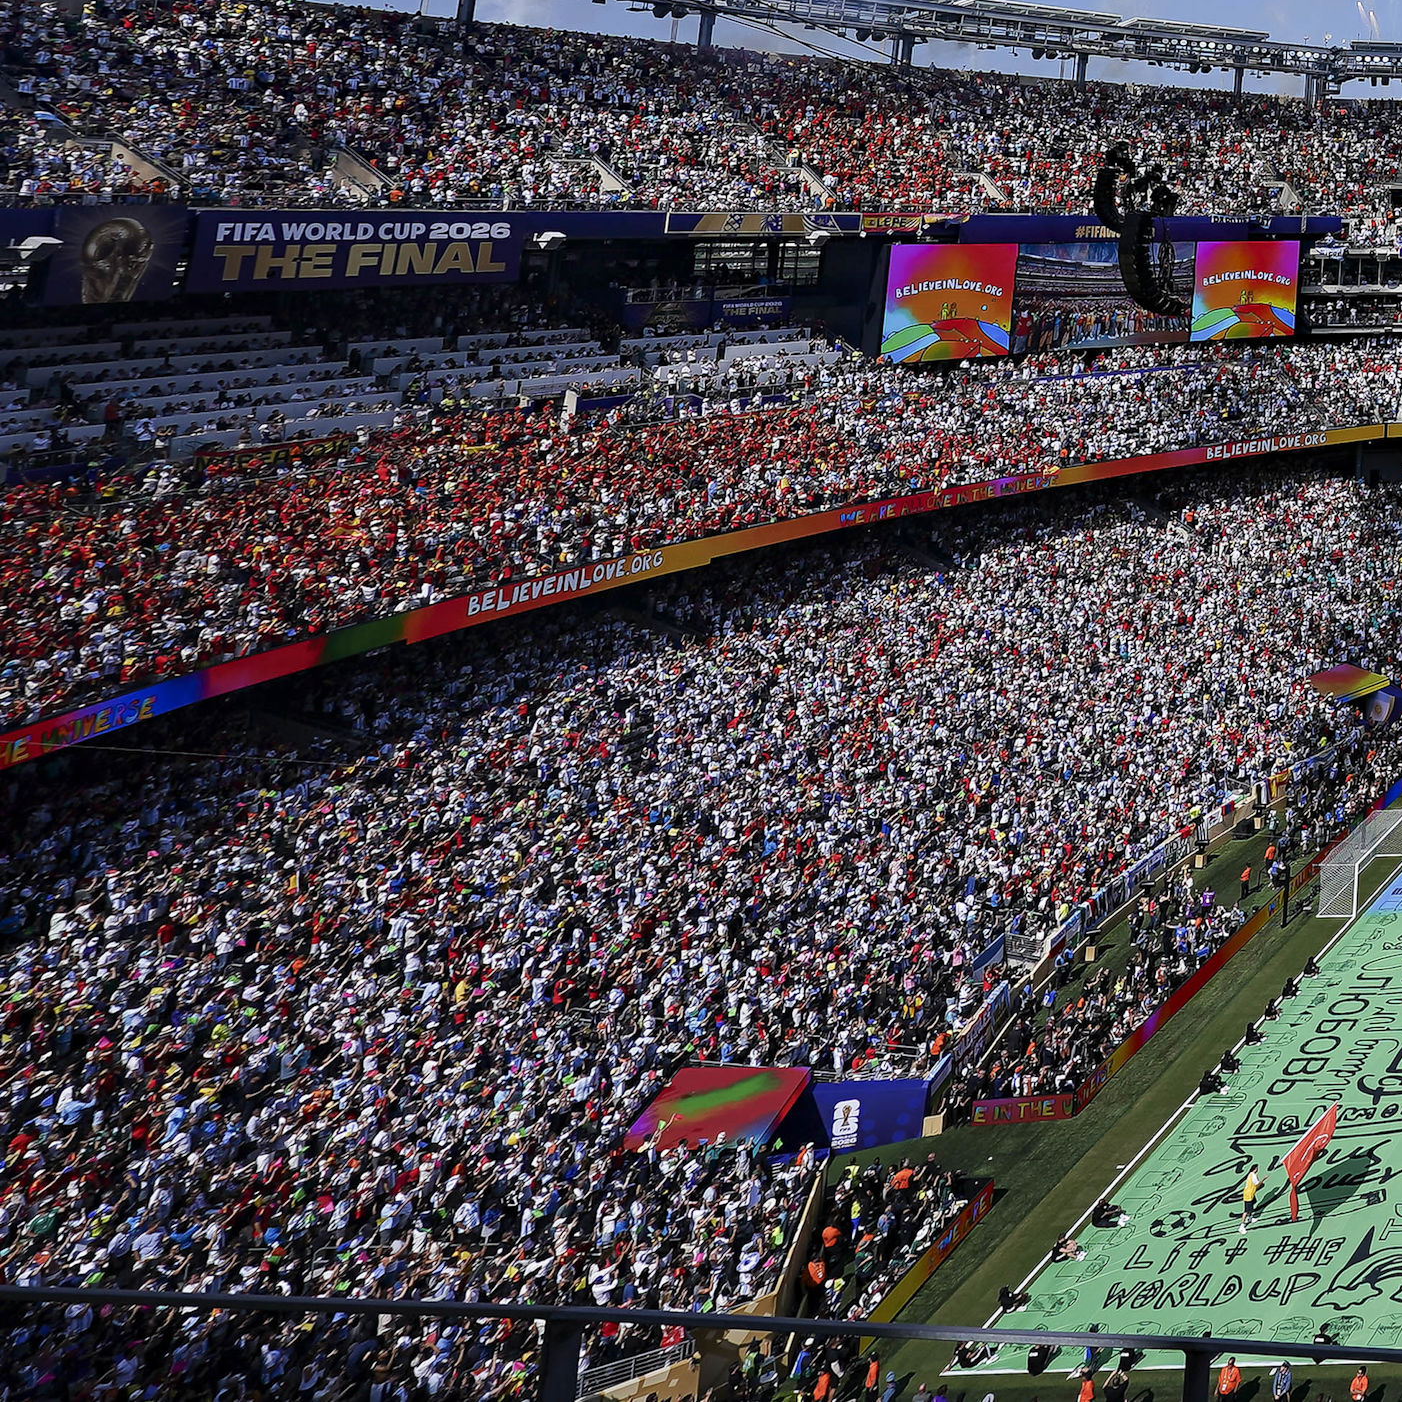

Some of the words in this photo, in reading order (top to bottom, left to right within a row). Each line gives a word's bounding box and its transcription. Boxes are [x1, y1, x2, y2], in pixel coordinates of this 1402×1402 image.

[216, 223, 292, 242] FIFA
[295, 223, 376, 241] WORLD
[379, 223, 426, 241] CUP
[428, 222, 512, 240] 2026
[213, 244, 333, 281] THE
[345, 242, 506, 278] FINAL
[895, 278, 1003, 299] BELIEVEINLOVE.ORG
[1202, 269, 1291, 287] BELIEVEINLOVE.ORG
[1205, 432, 1327, 460] BELIEVEINLOVE.ORG
[869, 504, 897, 521] ARE
[970, 482, 997, 500] THE
[467, 551, 664, 617] BELIEVEINLOVE.ORG
[0, 735, 32, 765] HE
[41, 696, 156, 753] UNIVERSE
[1017, 1100, 1055, 1119] THE
